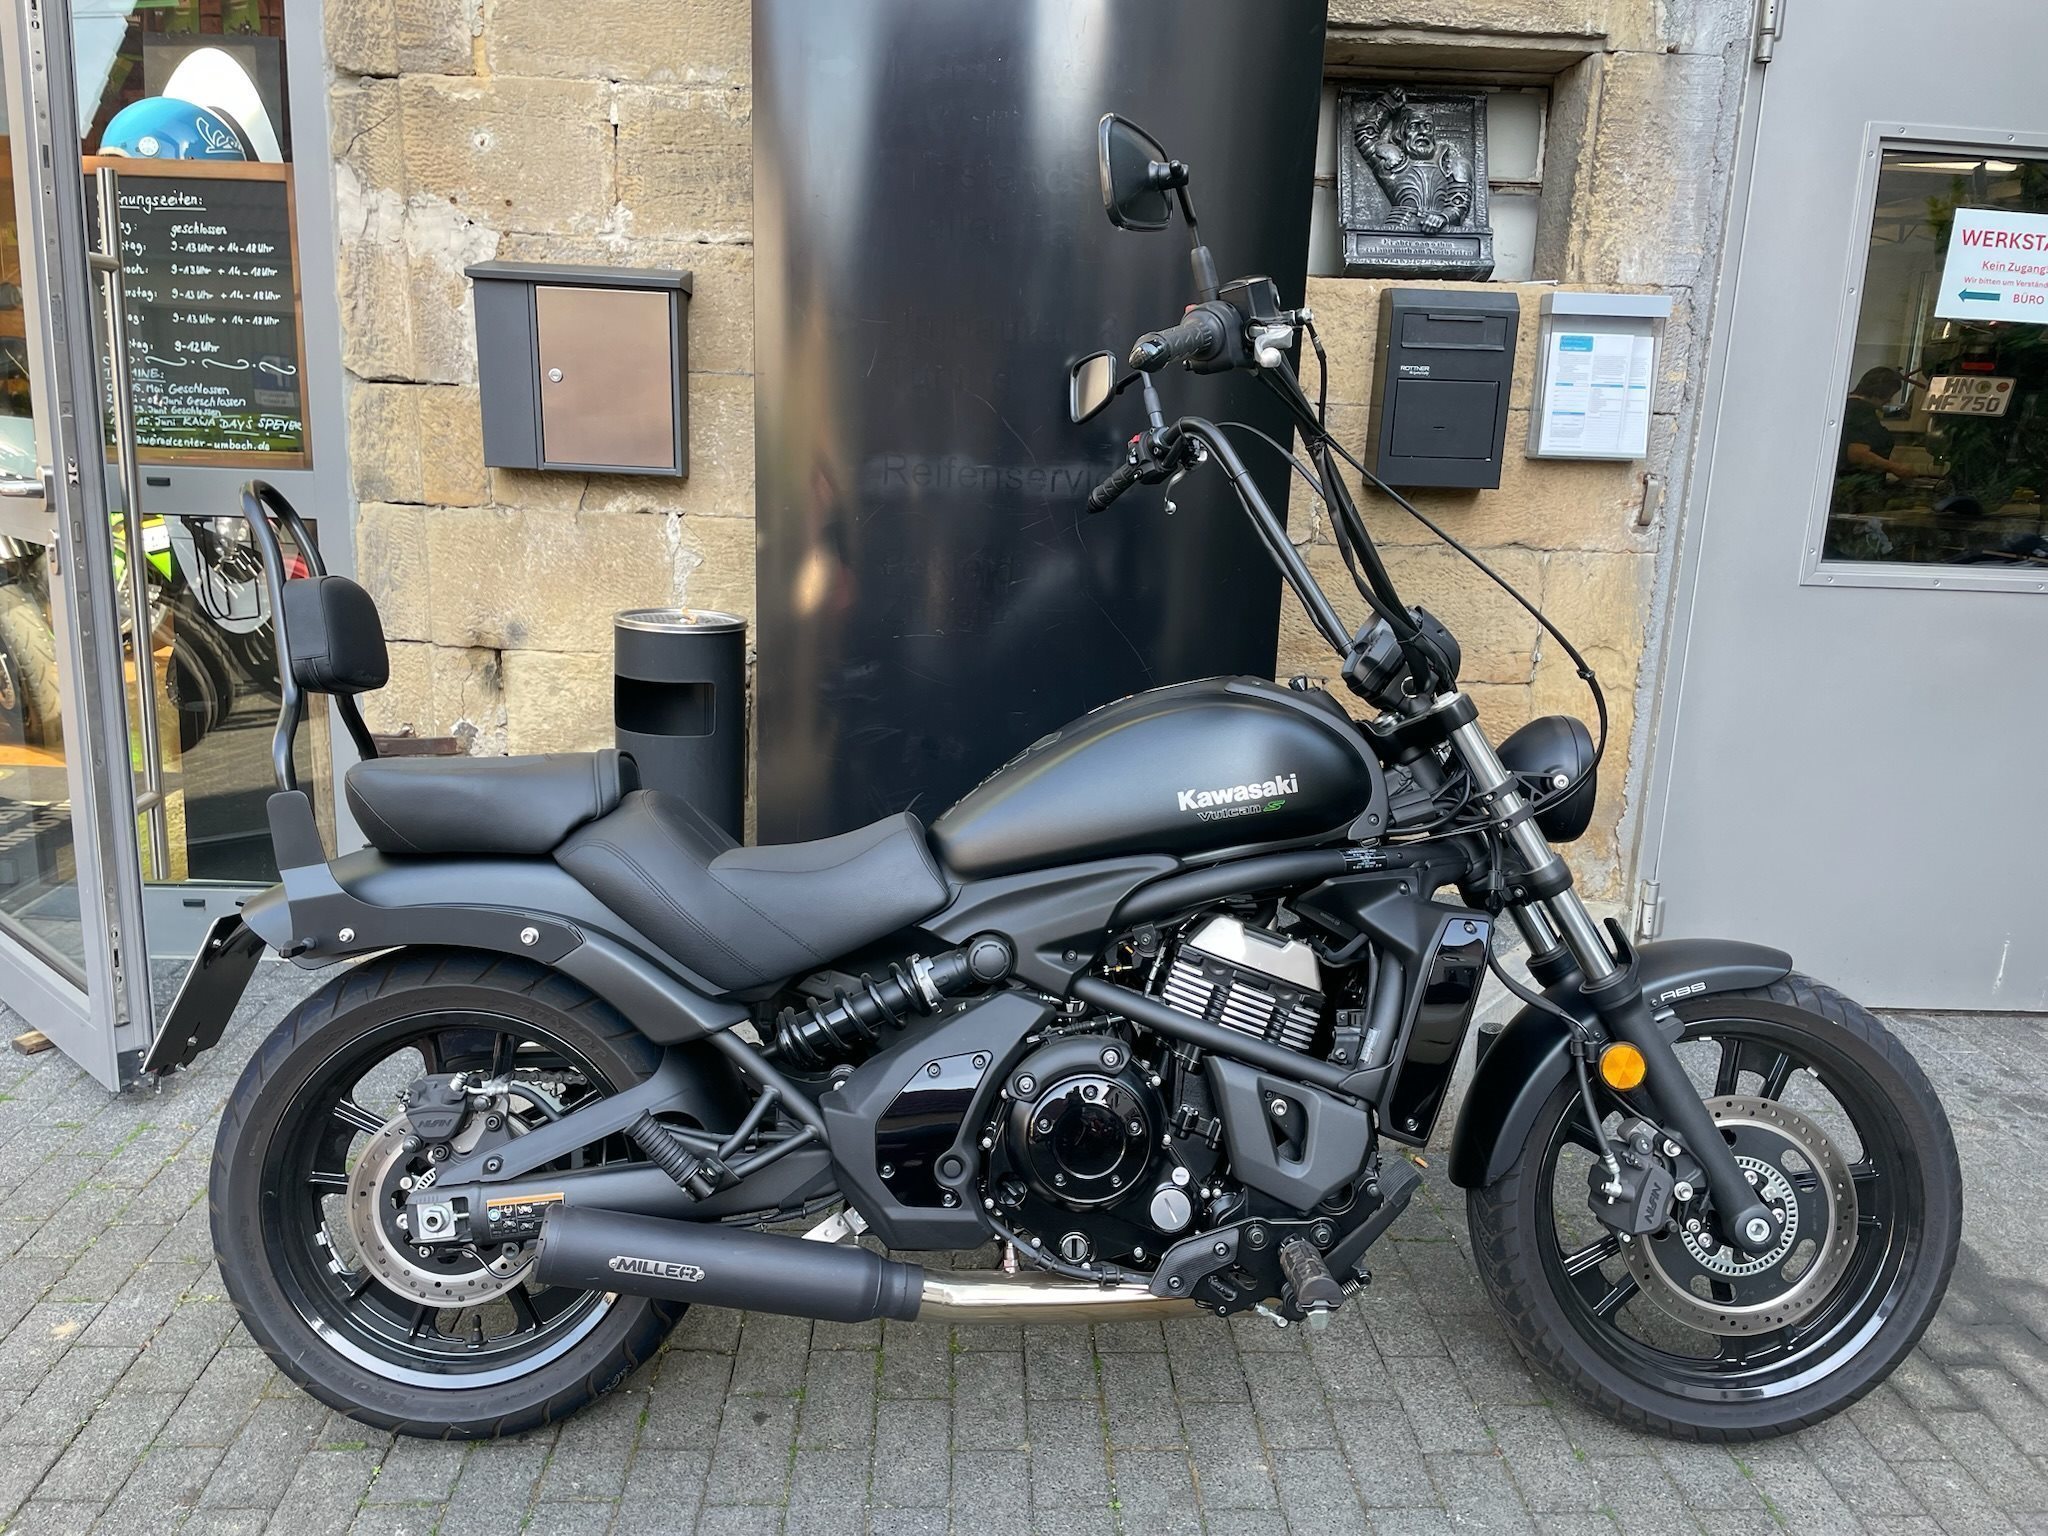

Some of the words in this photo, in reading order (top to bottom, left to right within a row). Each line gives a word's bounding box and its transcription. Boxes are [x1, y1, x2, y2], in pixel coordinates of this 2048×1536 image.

[98, 189, 203, 215] nungszeiten:
[169, 221, 228, 238] geschlossen
[1982, 260, 2006, 271] Kein
[1964, 276, 1978, 284] Wir
[1979, 278, 2001, 286] bitten
[2013, 291, 2045, 305] BÜRO
[1400, 364, 1430, 372] ROTTNER
[168, 383, 230, 396] Geschlossen
[1943, 378, 1975, 394] HN
[186, 396, 246, 408] Geschlossen
[1926, 394, 1958, 411] MF
[1959, 396, 2000, 413] 750
[182, 416, 216, 427] KAWA
[219, 418, 254, 431] DAYS
[258, 417, 302, 432] SPEYER
[112, 433, 270, 451] zweiradcenter-umbach.de
[1177, 773, 1299, 811] Kawasaki
[1197, 802, 1262, 823] Vulcan
[1263, 799, 1287, 813] S
[1660, 981, 1707, 1002] ABS
[615, 1258, 698, 1280] MILLER
